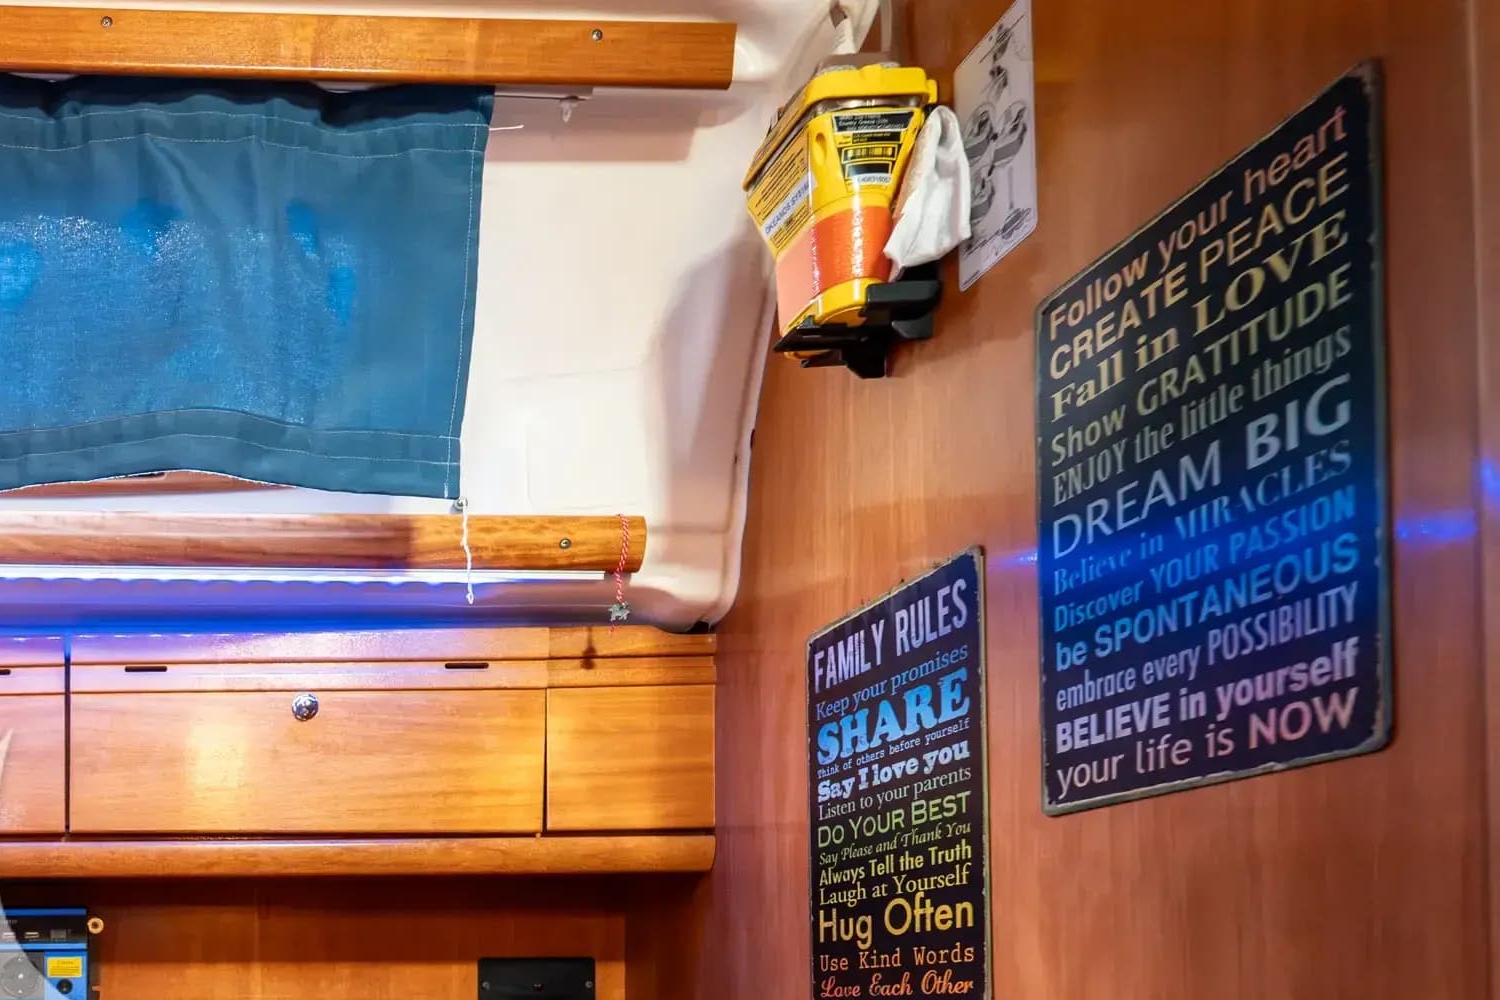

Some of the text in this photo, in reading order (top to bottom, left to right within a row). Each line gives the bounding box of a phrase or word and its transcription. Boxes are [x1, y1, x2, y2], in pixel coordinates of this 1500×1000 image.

[1050, 104, 1348, 342] Follow your heart
[1050, 151, 1349, 380] CREATE PEACE
[1051, 209, 1348, 423] Fall in LOVE
[1051, 262, 1354, 467] Show GRATITUDE
[1052, 324, 1352, 507] ENJOY the little things
[1052, 373, 1352, 560] DREAM BIG
[1053, 439, 1352, 597] Believe in MIRACLES
[1054, 484, 1356, 634] Discover YOUR PASSION
[814, 578, 968, 694] FAMILY RULES
[1056, 532, 1361, 673] be SPONTANEOUS
[1056, 580, 1359, 713] embrace every POSSIBILITY
[816, 643, 969, 721] Keep your promises
[817, 666, 971, 766] SHARE
[1056, 635, 1360, 755] BELIEVE in yourself
[817, 717, 971, 779] Think of others before yourself
[817, 739, 971, 803] Say I love you
[819, 766, 972, 821] Listen to your parents
[1057, 686, 1359, 800] your life is NOW
[819, 820, 972, 868] Say Please and Thank You
[819, 838, 972, 887] Always Tell the Truth
[819, 862, 972, 908] Laugh at Yourself
[819, 891, 974, 950] Hug Often
[819, 942, 975, 973] Use Kind Words
[820, 969, 975, 998] Love Each Other
